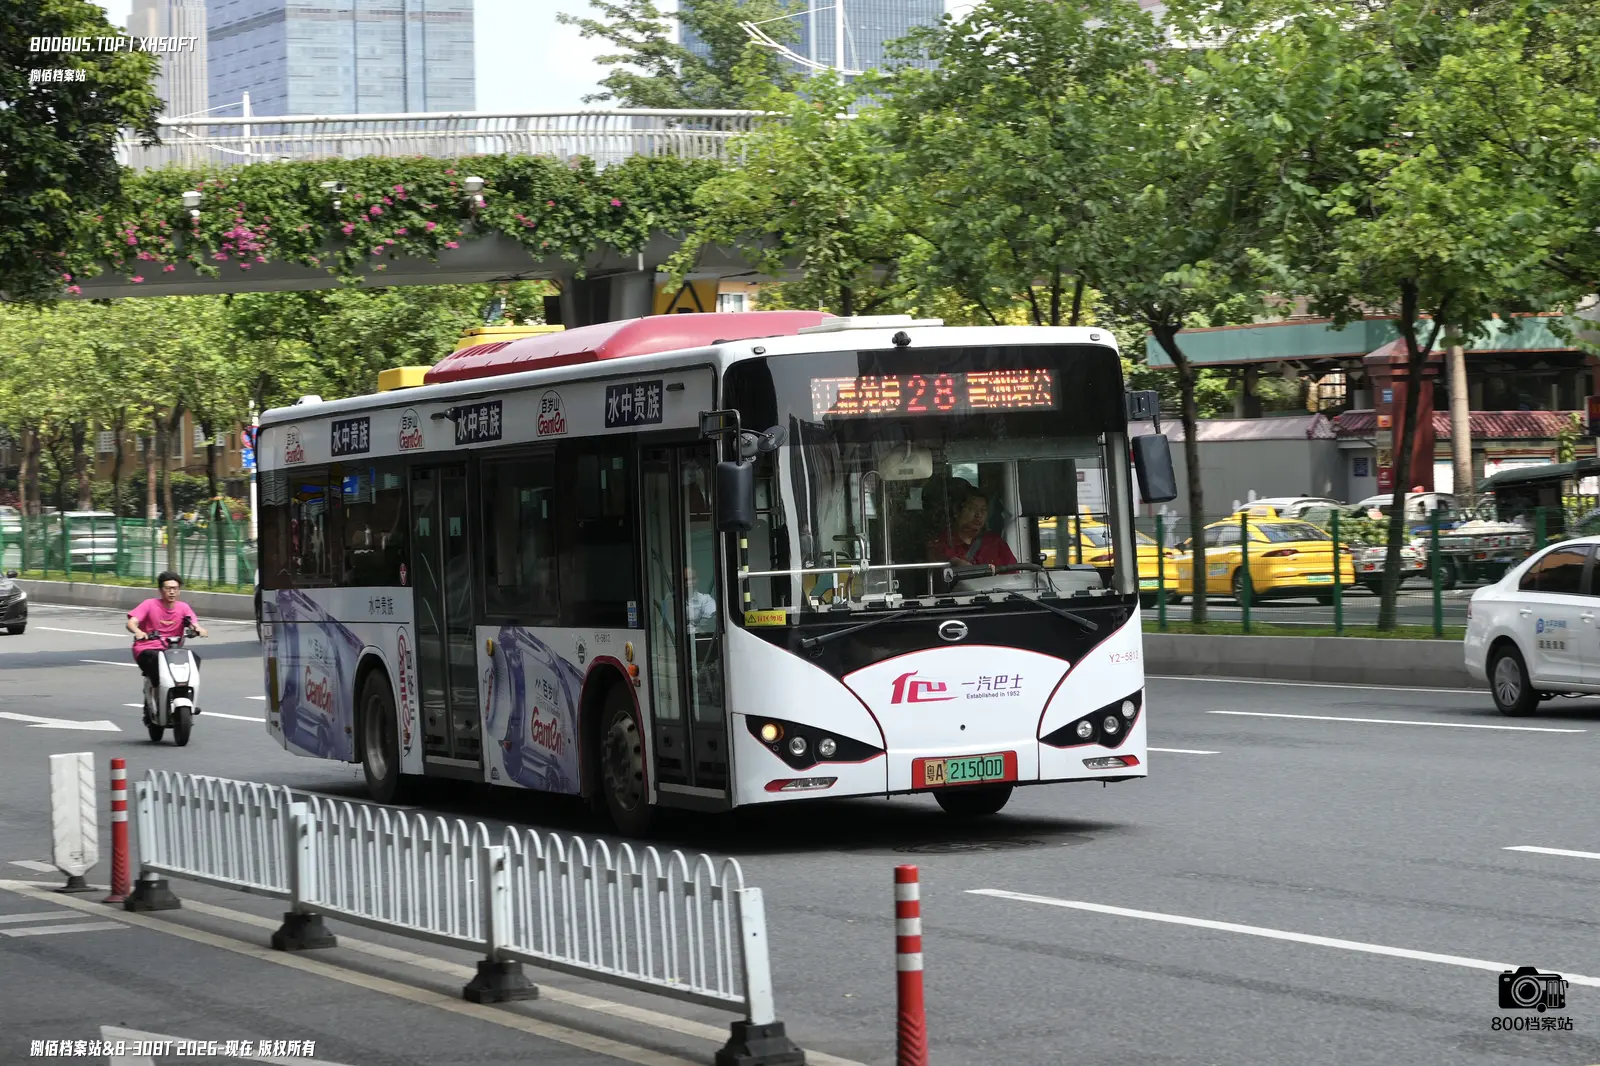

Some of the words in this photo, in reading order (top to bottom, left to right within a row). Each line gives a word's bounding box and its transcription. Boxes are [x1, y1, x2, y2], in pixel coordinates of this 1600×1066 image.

[541, 398, 560, 414] 百岁山
[607, 385, 660, 423] 水中贵族
[907, 374, 956, 411] 28
[332, 420, 369, 453] 水中贵族
[457, 406, 500, 440] 水中贵族
[537, 412, 566, 434] Ganten
[961, 673, 1024, 692] 一汽巴士
[966, 691, 999, 700] Established
[1006, 690, 1021, 698] 1952
[531, 705, 562, 755] Ganten
